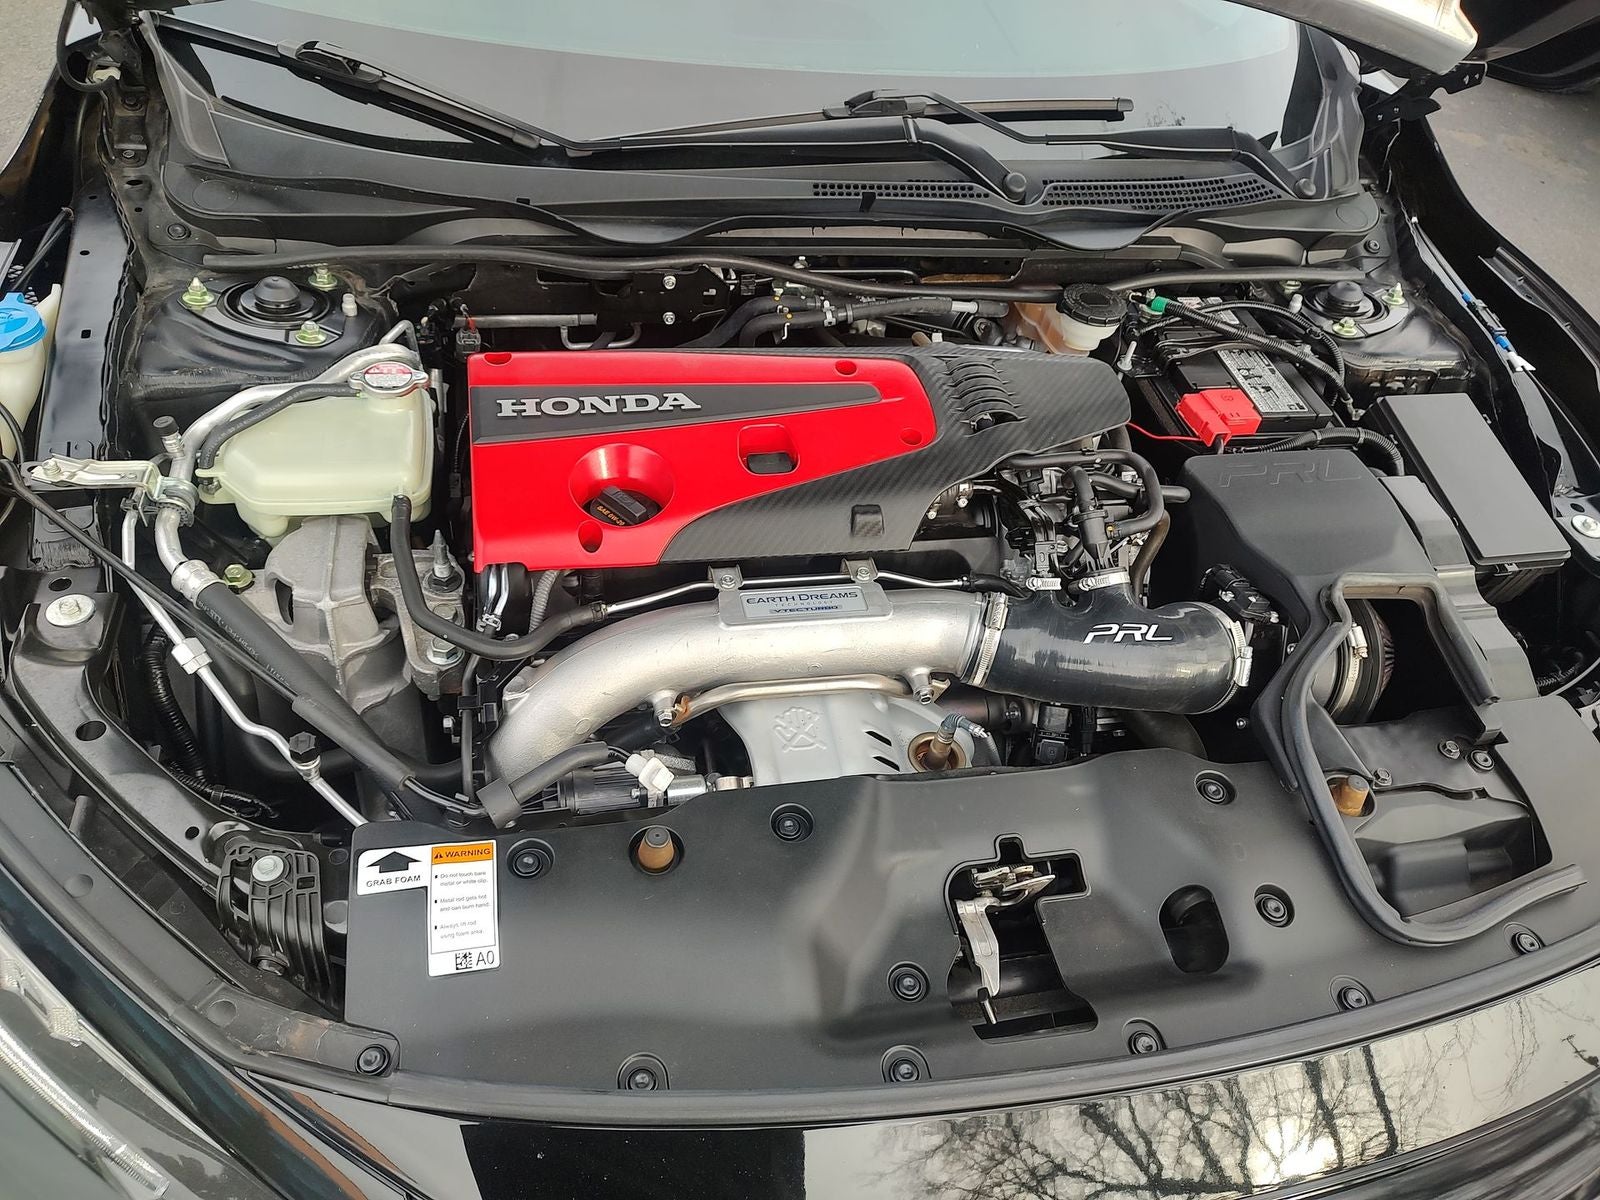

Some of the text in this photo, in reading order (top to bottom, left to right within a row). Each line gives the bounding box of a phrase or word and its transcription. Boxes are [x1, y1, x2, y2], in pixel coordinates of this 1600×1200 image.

[496, 392, 702, 417] HONDA
[1218, 459, 1362, 488] PRL
[596, 505, 610, 516] SAE
[746, 591, 858, 604] EARTH DREAMS
[1082, 623, 1173, 644] PRL
[445, 848, 491, 858] WARNING
[366, 874, 421, 888] GRAB FOAM
